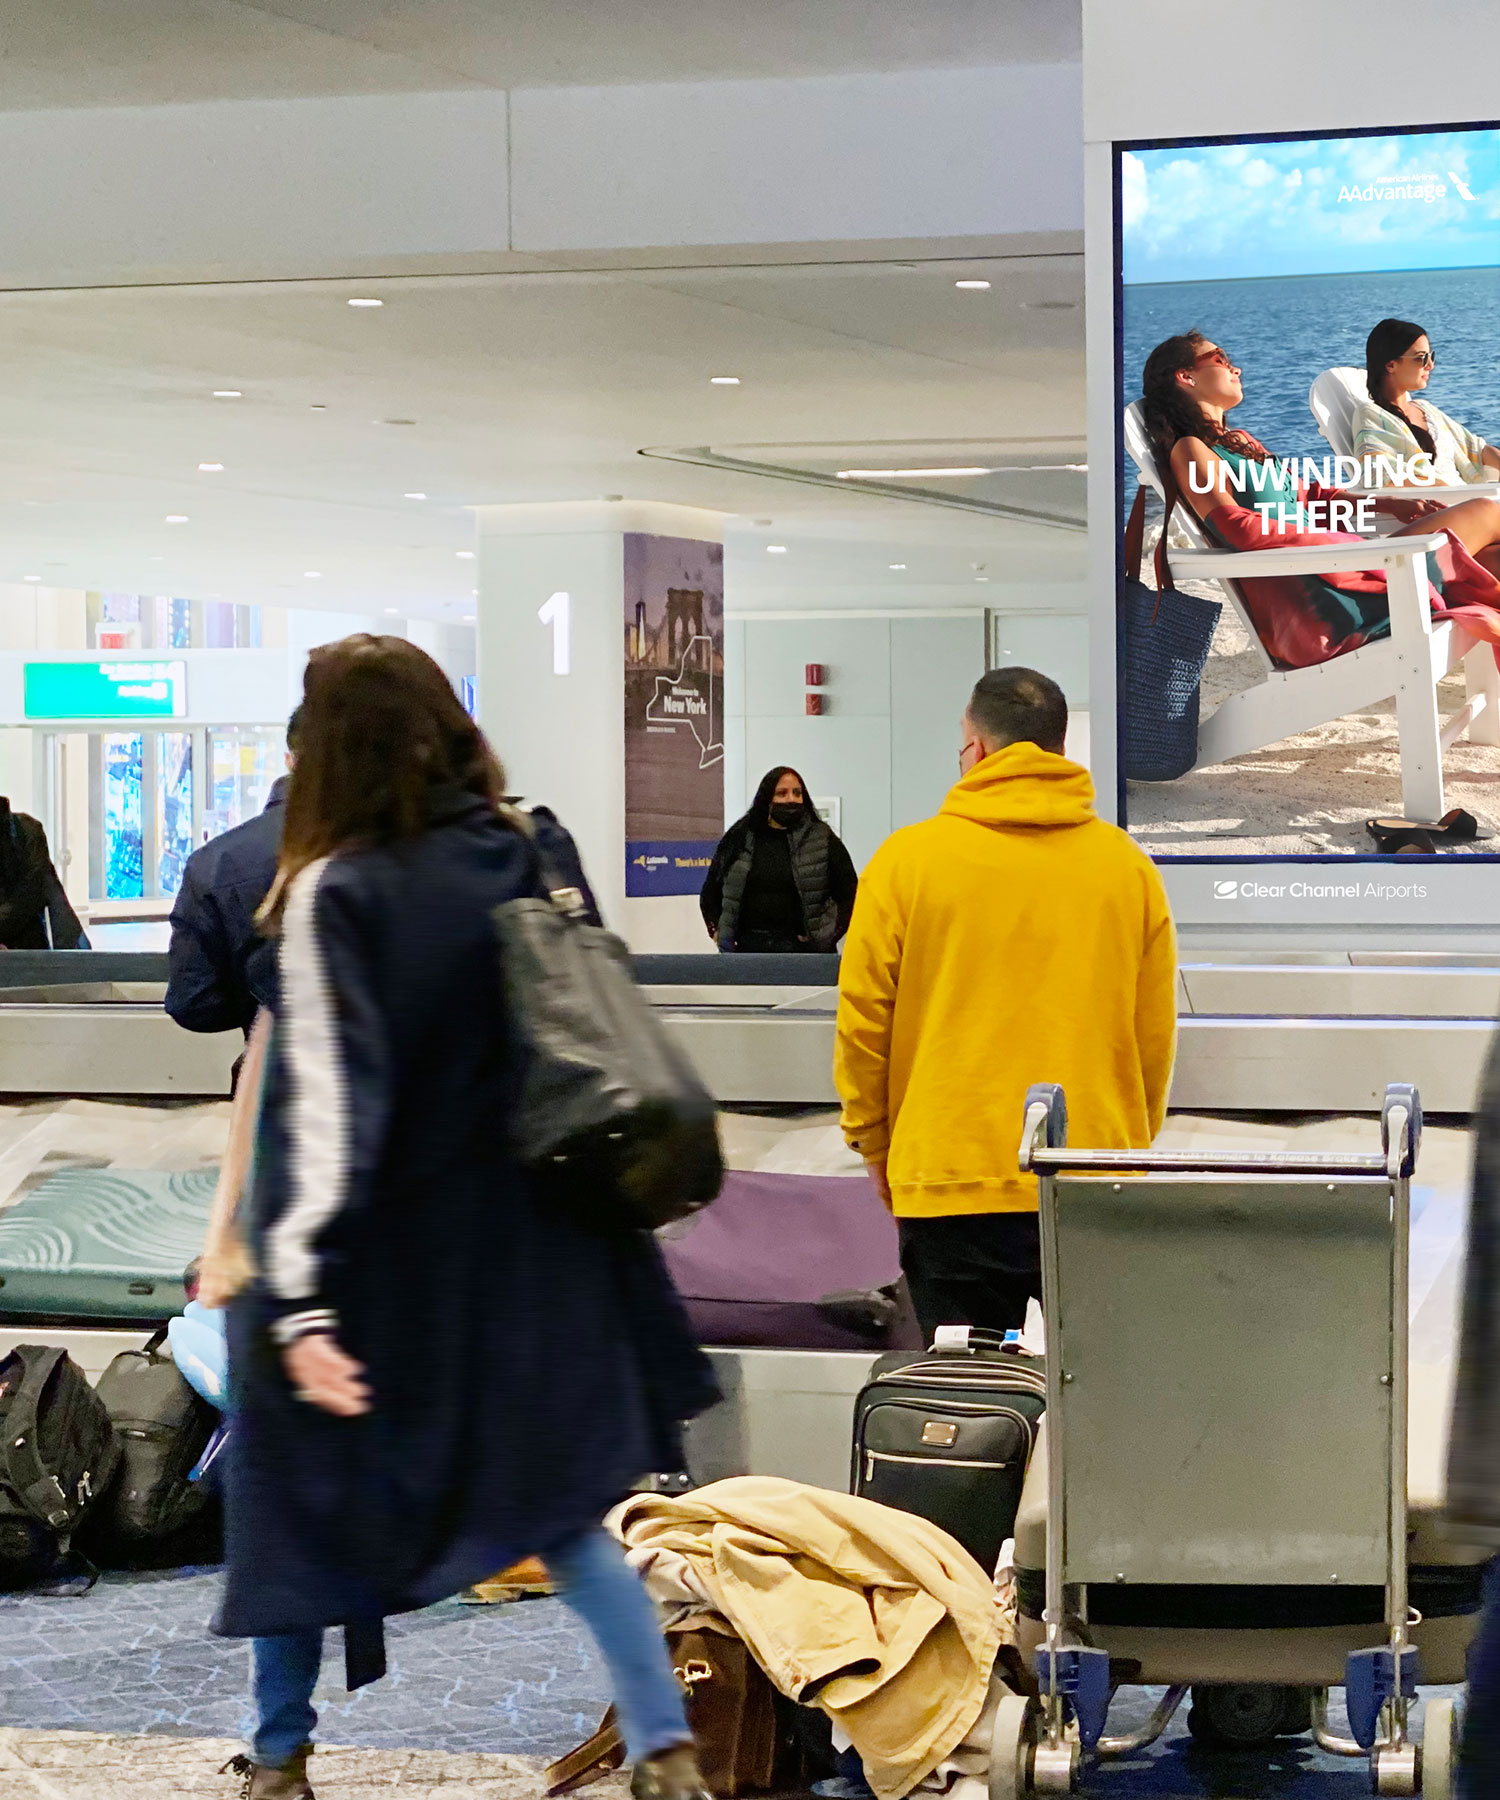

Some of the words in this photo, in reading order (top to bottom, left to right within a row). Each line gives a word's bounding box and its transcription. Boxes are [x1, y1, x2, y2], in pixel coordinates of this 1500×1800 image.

[1337, 183, 1447, 203] AAdvantage
[1188, 452, 1437, 494] UNWINDING
[1254, 498, 1377, 536] THERE
[537, 592, 570, 675] 1
[664, 695, 685, 713] New
[685, 697, 706, 715] York
[1240, 882, 1287, 898] Clear
[1289, 882, 1360, 898] Channel
[1363, 882, 1428, 901] Airports
